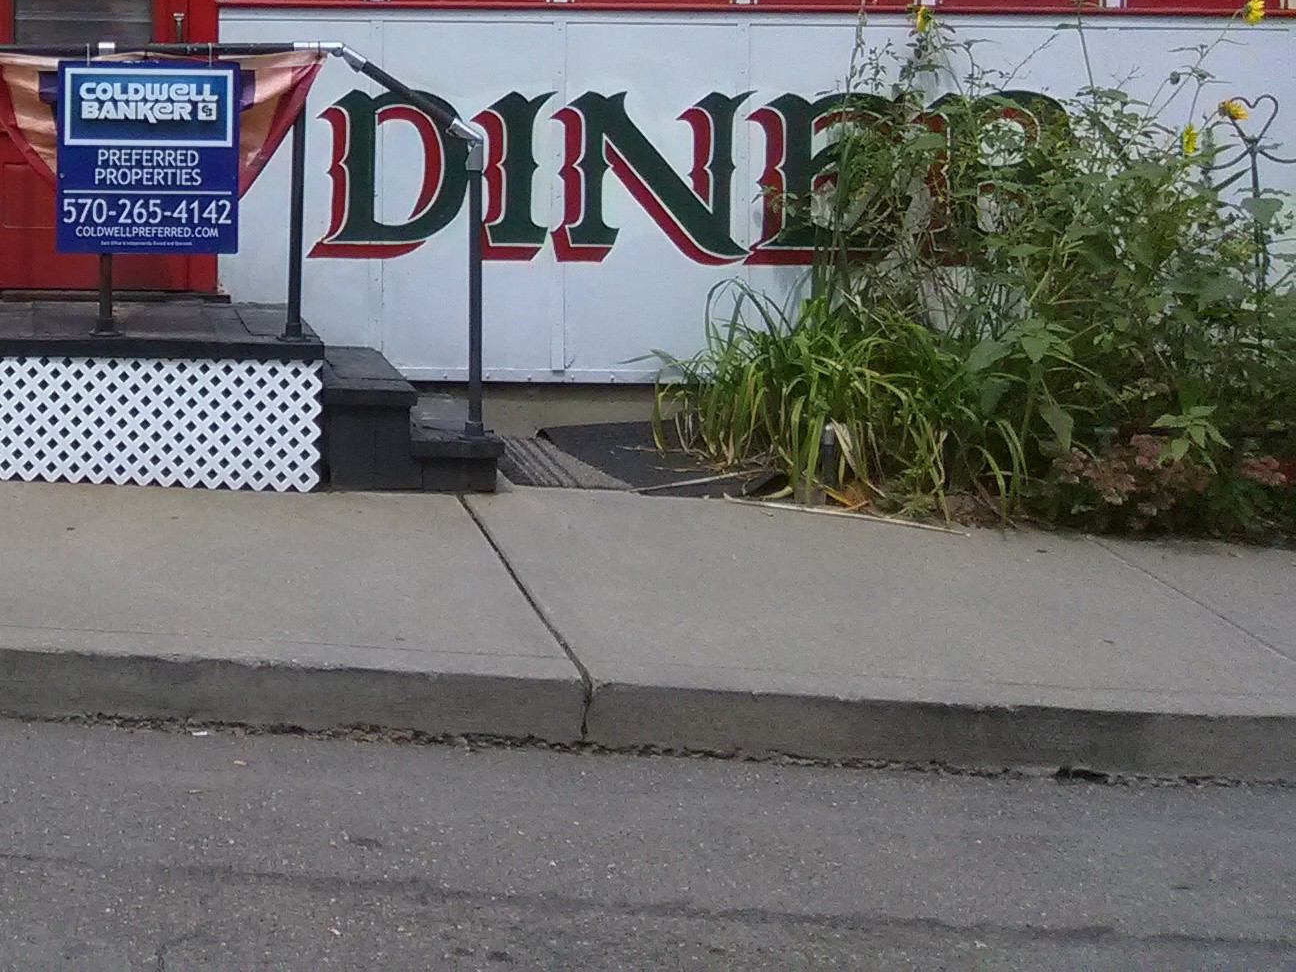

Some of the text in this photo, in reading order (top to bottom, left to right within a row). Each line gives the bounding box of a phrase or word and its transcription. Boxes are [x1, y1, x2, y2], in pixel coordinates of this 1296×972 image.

[79, 82, 218, 102] COLDWELL
[81, 100, 192, 124] BANKER
[97, 149, 199, 167] PREFERRED
[94, 168, 202, 186] PROPERTIES
[63, 198, 232, 225] 570-265-4142
[75, 226, 219, 239] COLDWELLPREFERRED.COM
